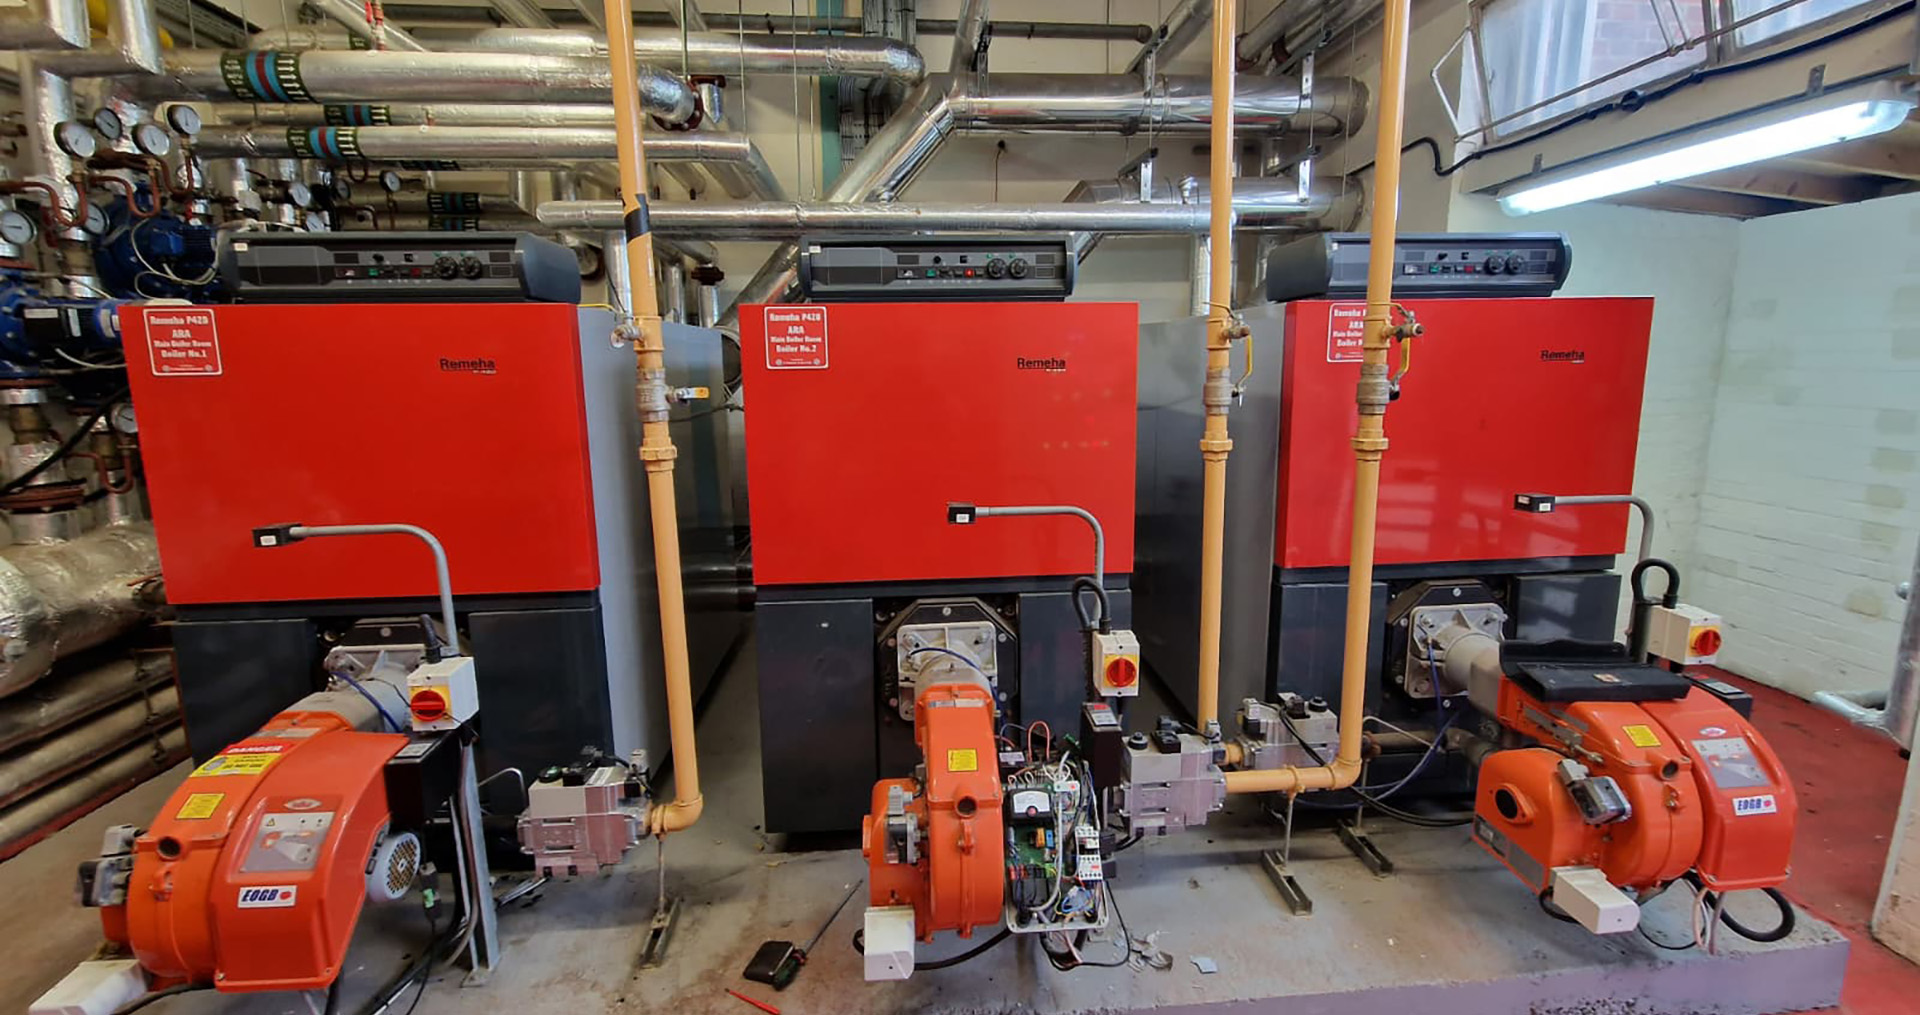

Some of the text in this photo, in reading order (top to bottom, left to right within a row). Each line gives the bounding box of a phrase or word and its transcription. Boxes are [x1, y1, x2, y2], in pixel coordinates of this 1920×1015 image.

[769, 313, 800, 321] Remeha
[1334, 309, 1361, 317] Remeha
[150, 315, 185, 325] Remeha
[172, 329, 191, 338] ARA
[787, 325, 805, 334] ARA
[161, 349, 186, 358] Boiler
[776, 345, 798, 353] Boiler
[1541, 350, 1585, 361] Remeha
[440, 358, 495, 370] Remeha
[1017, 357, 1066, 369] Remeha
[227, 745, 284, 753] DANGER
[1737, 798, 1762, 810] EOGB
[241, 889, 279, 902] EOGB
